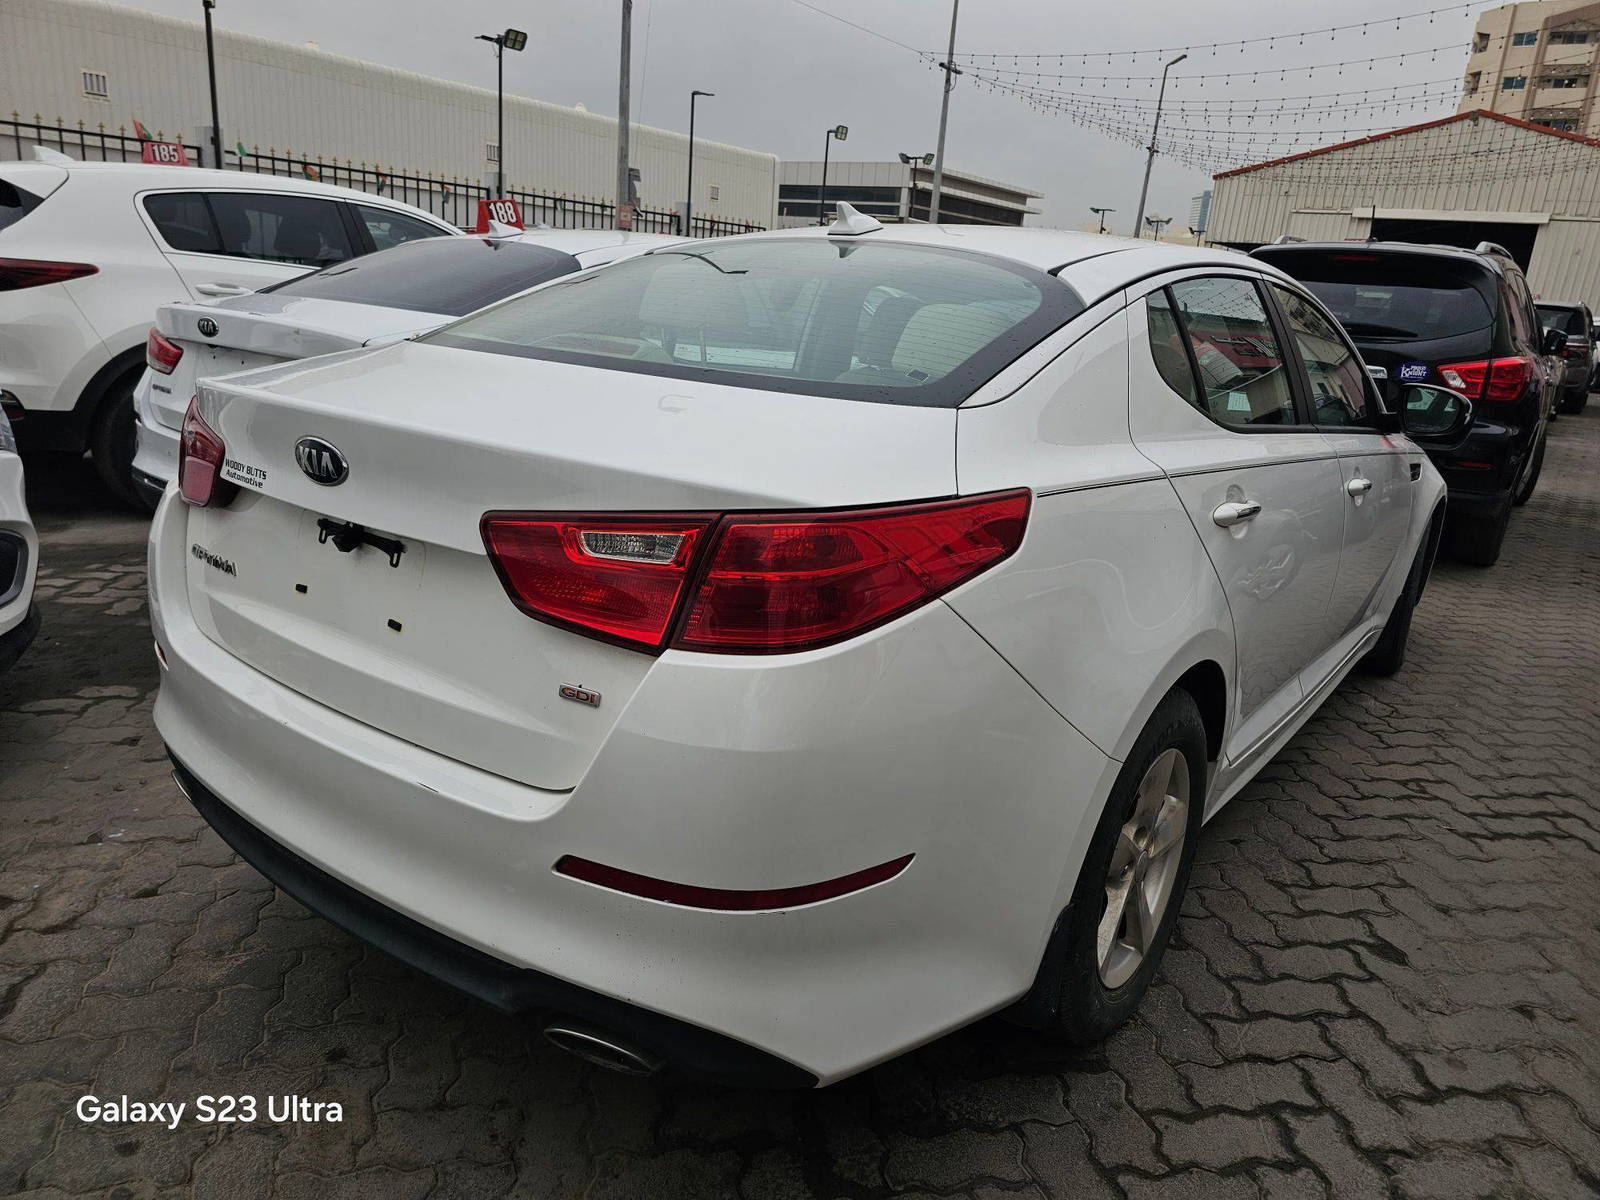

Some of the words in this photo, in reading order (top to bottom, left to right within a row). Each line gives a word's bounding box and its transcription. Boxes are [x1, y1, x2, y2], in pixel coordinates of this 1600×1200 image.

[152, 145, 179, 162] 185
[489, 201, 517, 224] 188
[225, 458, 246, 473] WOODY
[246, 465, 267, 480] BUTTS
[298, 445, 338, 479] KIA
[225, 469, 263, 489] Automotive
[561, 687, 596, 704] GDI
